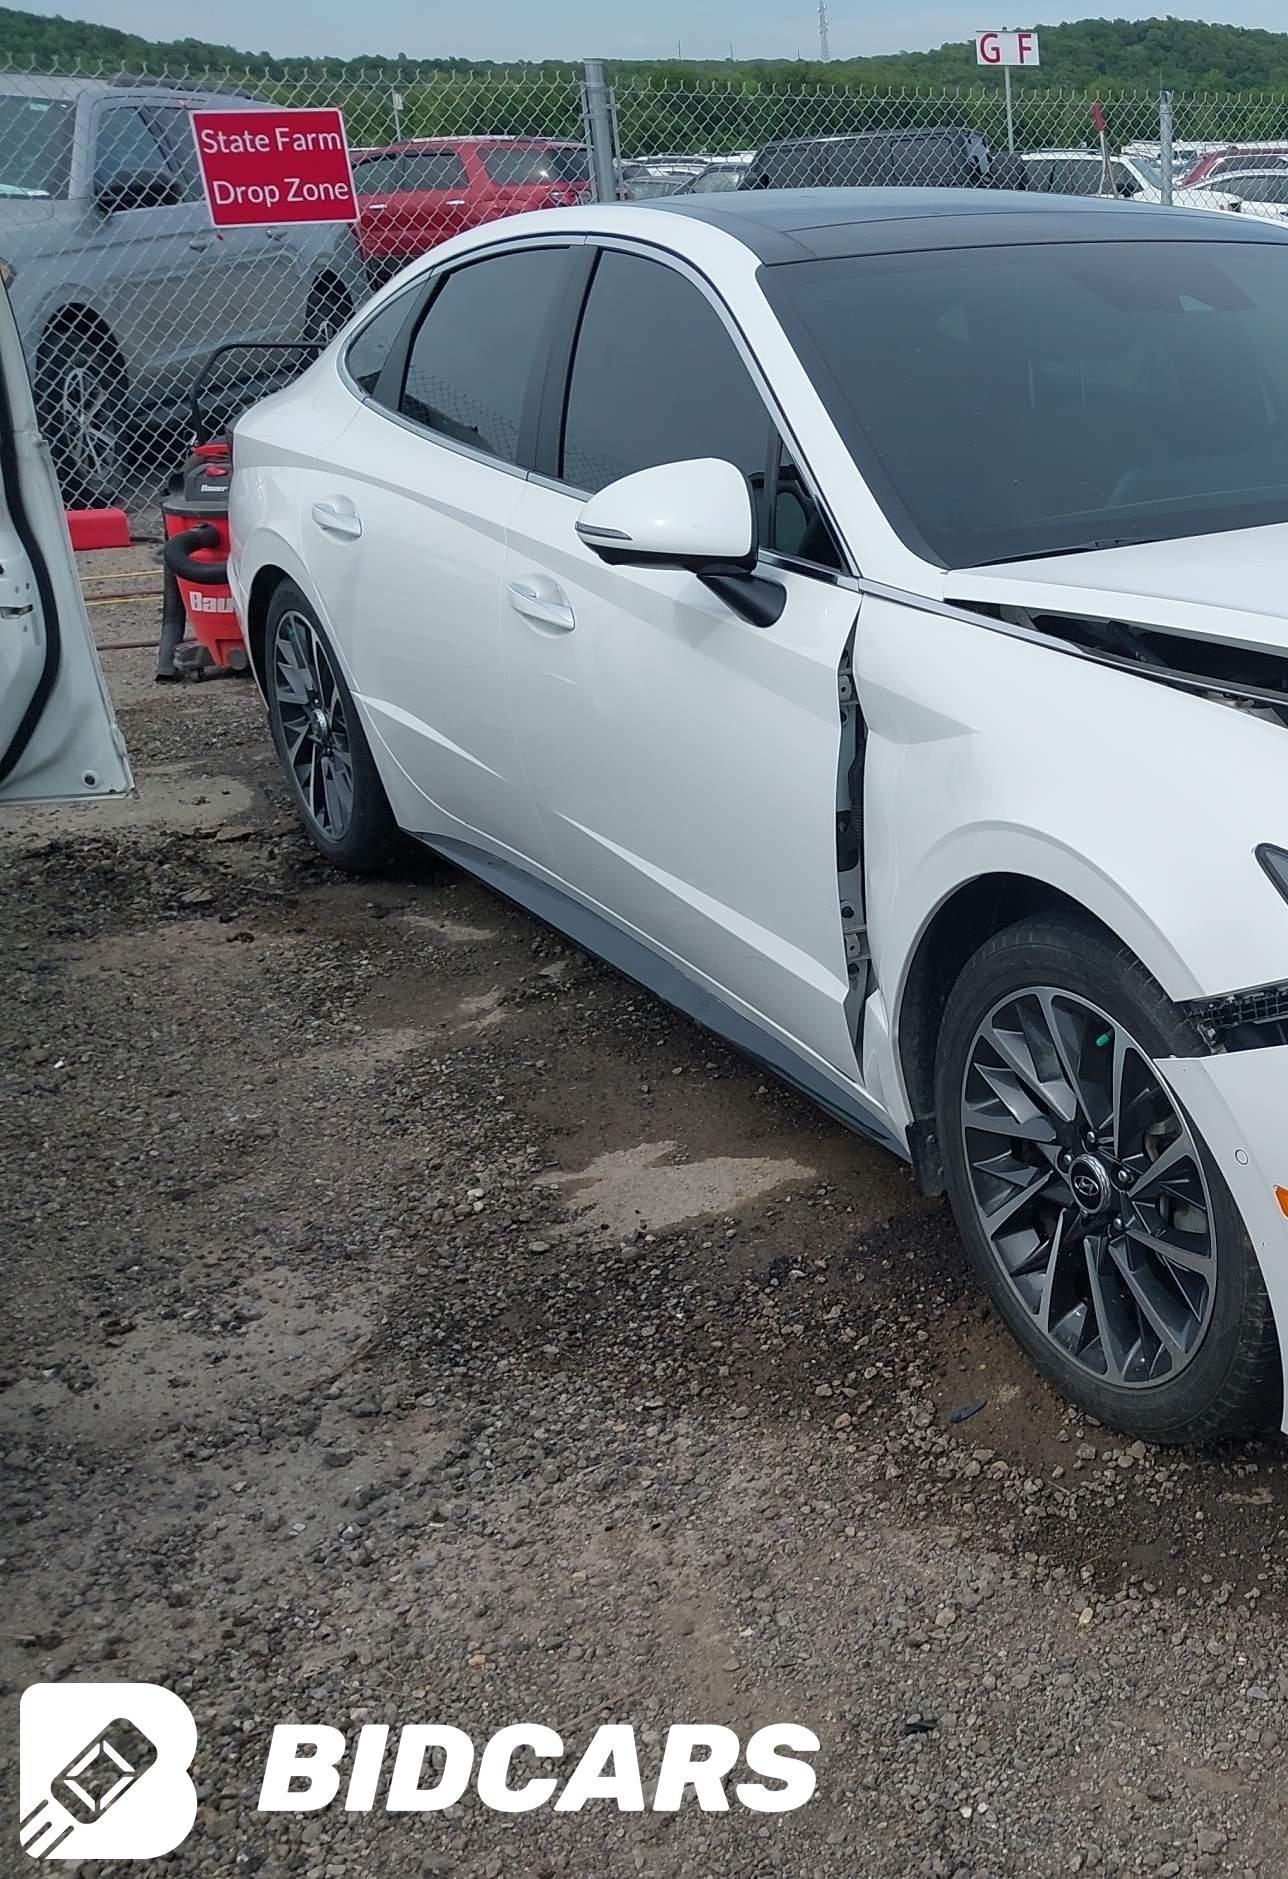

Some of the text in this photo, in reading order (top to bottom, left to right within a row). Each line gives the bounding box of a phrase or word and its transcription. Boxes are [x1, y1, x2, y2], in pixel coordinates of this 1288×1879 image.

[980, 33, 1032, 64] G F
[201, 127, 342, 153] State Farm
[212, 178, 349, 208] Drop Zone
[189, 591, 234, 613] Bau
